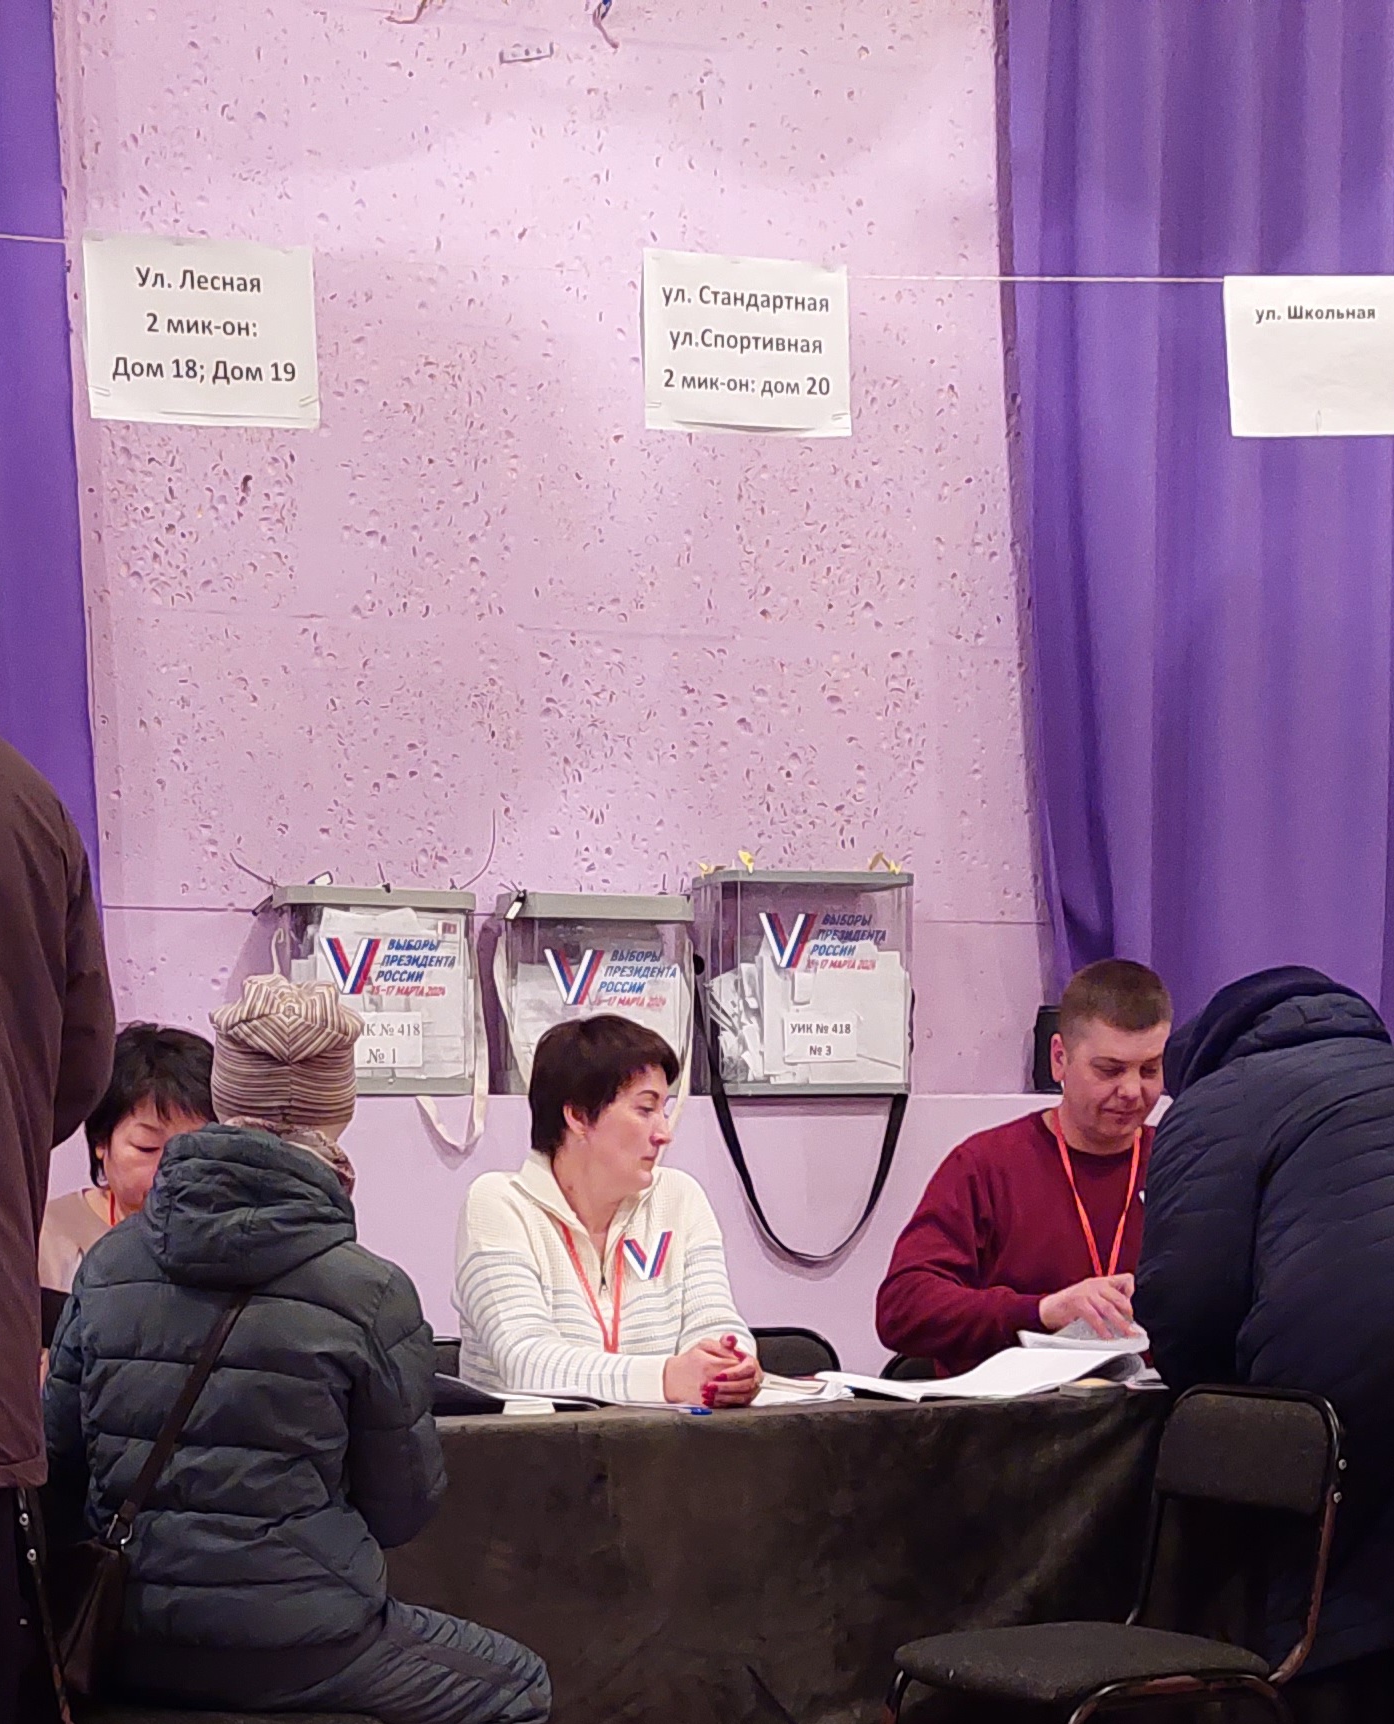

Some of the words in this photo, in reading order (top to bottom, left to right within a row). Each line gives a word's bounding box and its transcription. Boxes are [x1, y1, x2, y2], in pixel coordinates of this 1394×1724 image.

[136, 266, 172, 288] Ул.
[179, 269, 261, 293] Лесная
[662, 287, 691, 306] ул.
[699, 285, 829, 313] Стандартная
[1255, 308, 1282, 324] ул.
[1287, 305, 1376, 320] Школьная
[146, 313, 159, 333] 2
[167, 318, 258, 337] мик-он:
[112, 357, 164, 381] Дом
[171, 359, 205, 384] 18;
[212, 361, 263, 385] Дом
[270, 362, 296, 382] 19
[663, 369, 675, 388] 2
[681, 375, 756, 393] мик-он:
[760, 380, 800, 397] дом
[806, 376, 830, 396] 20
[821, 913, 873, 926] ВЫБОРЫ
[815, 929, 886, 943] ПРЕЗИДЕНТА
[387, 939, 441, 952] ВЫБОРЫ
[810, 944, 856, 957] РОССИИ
[381, 955, 456, 969] ПРЕЗИДЕНТА
[610, 950, 664, 962] ВЫБОРЫ
[375, 970, 424, 983] РОССИИ
[604, 965, 677, 979] ПРЕЗИДЕНТА
[395, 986, 424, 996] МАРТА
[597, 981, 645, 994] РОССИИ
[379, 1024, 395, 1036] №
[398, 1024, 421, 1036] 418
[790, 1023, 813, 1034] УИК
[815, 1024, 829, 1034] №
[831, 1023, 851, 1034] 418
[366, 1048, 385, 1064] №
[809, 1045, 822, 1056] №
[825, 1045, 832, 1056] 3
